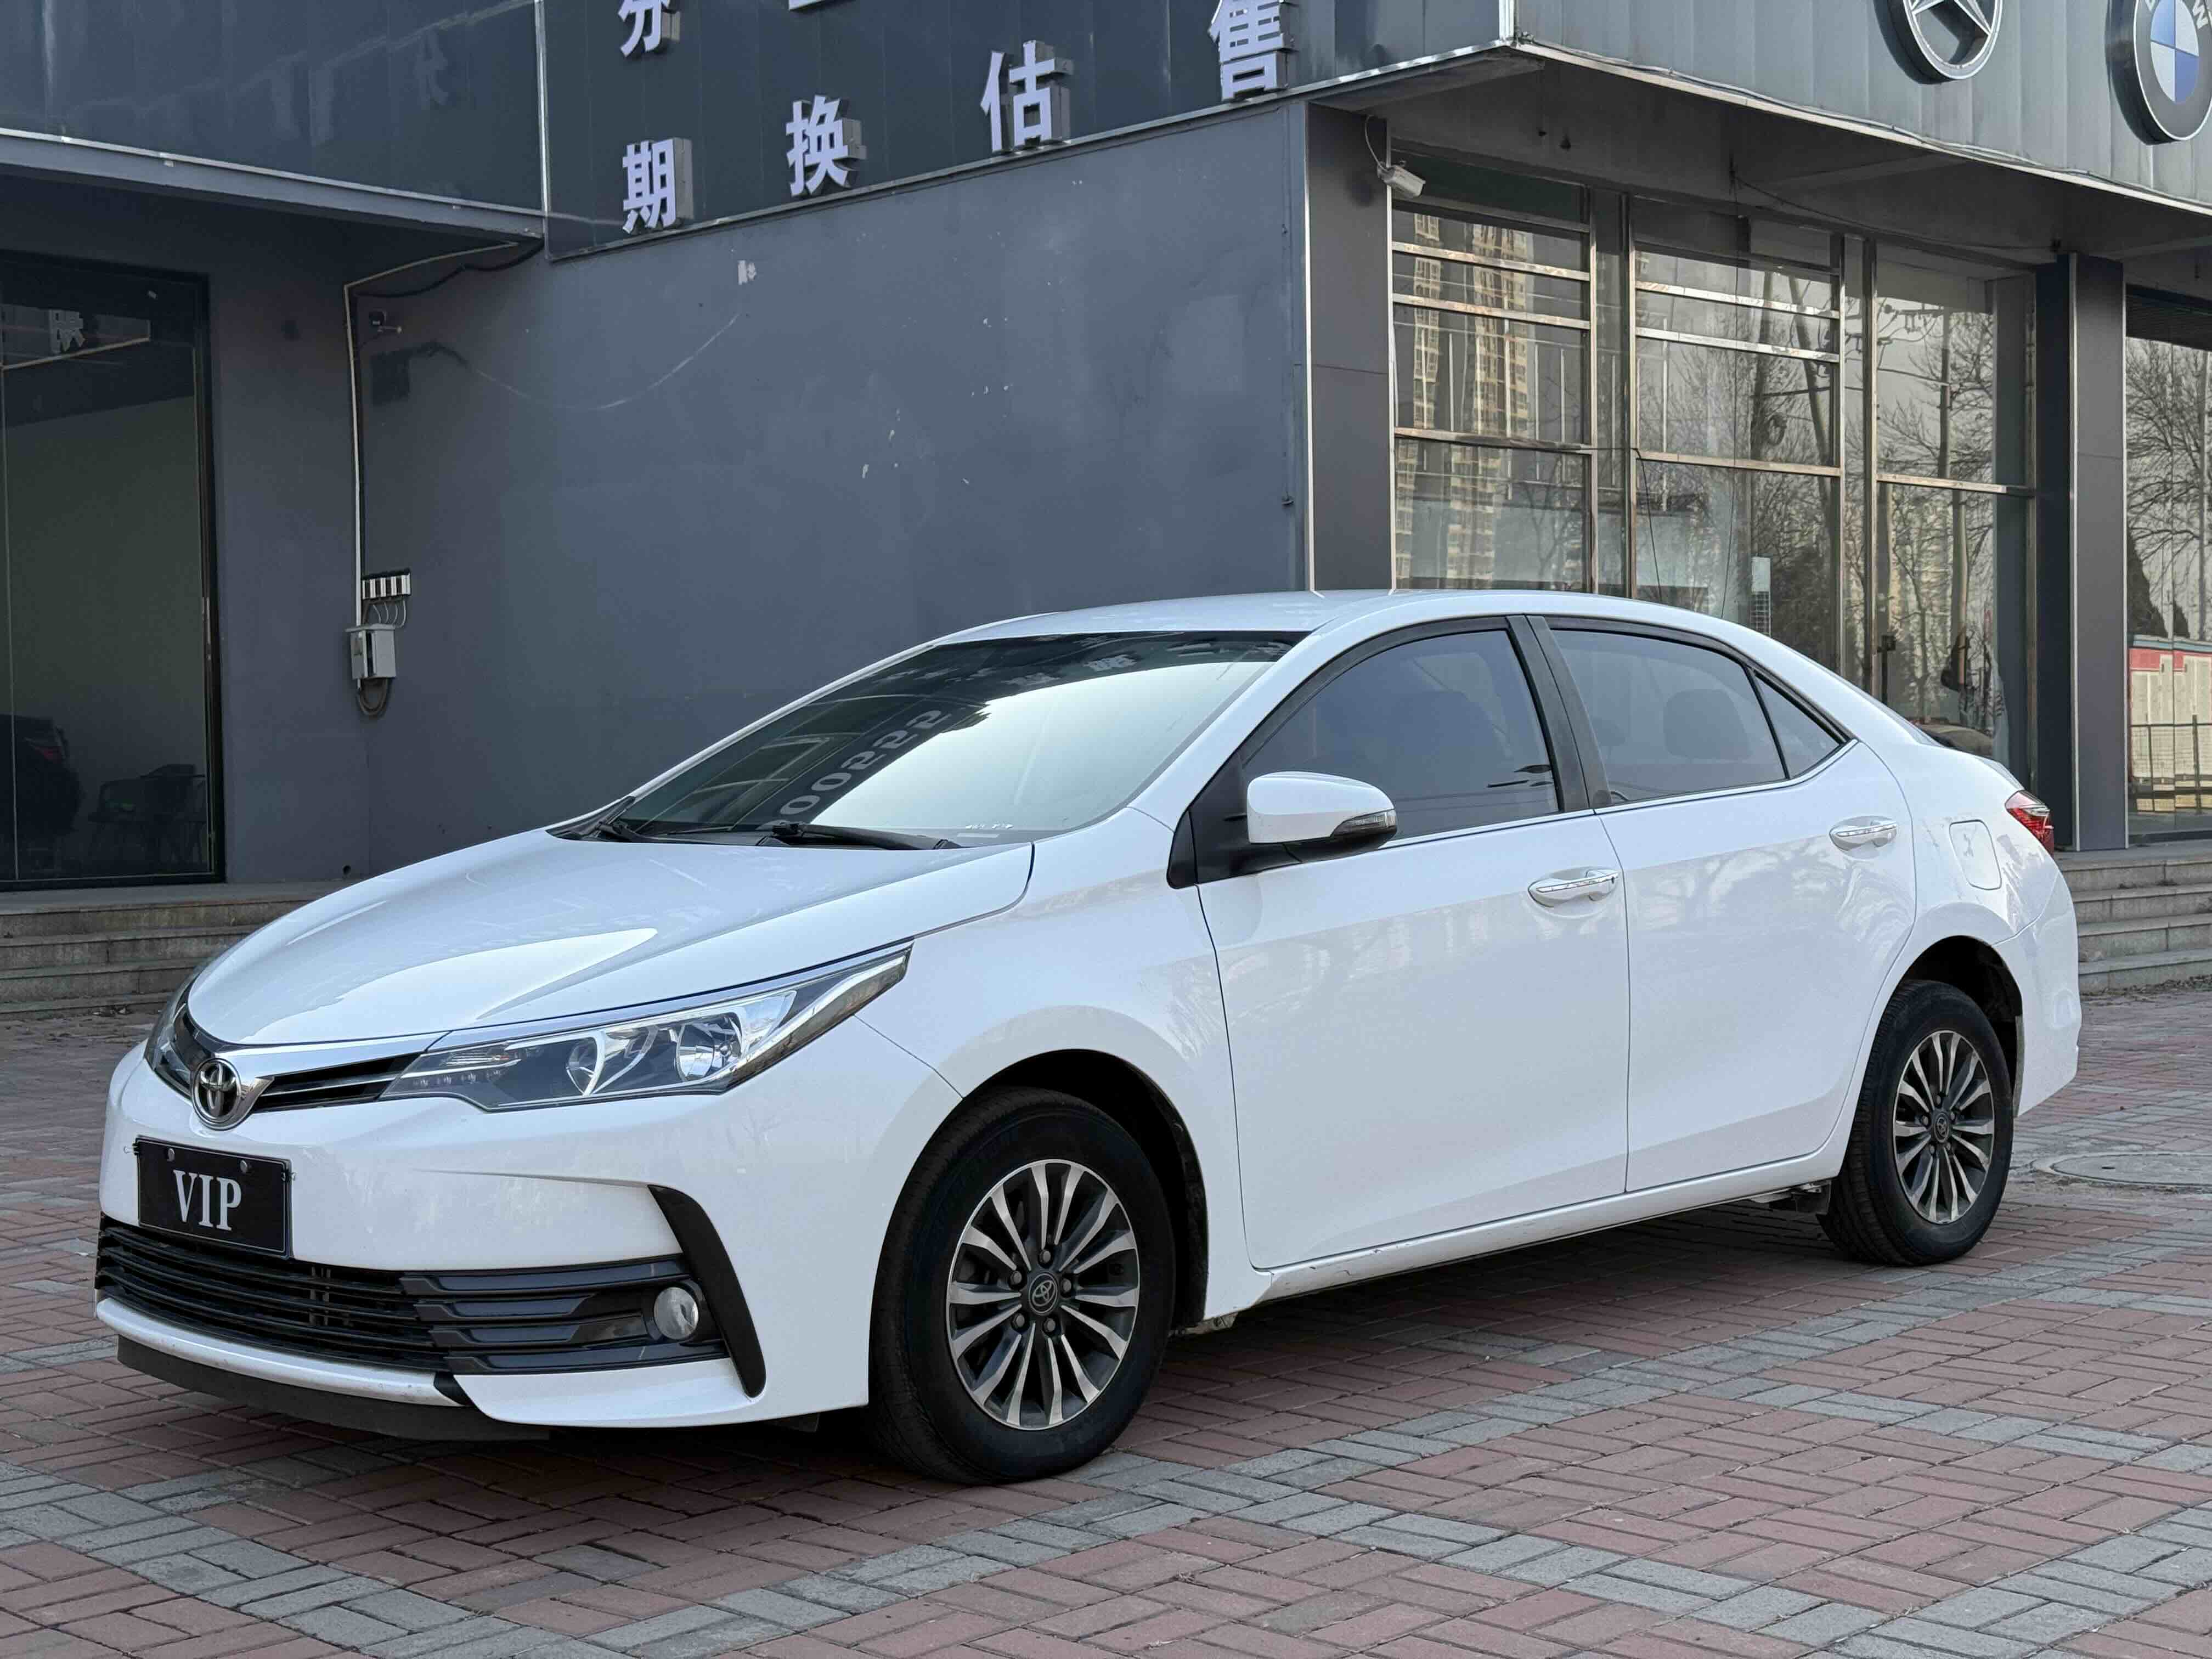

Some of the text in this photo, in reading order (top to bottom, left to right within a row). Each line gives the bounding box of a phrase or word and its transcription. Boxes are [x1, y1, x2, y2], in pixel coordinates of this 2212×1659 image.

[980, 40, 1056, 153] 估
[1207, 0, 1285, 101] 售
[173, 1169, 242, 1231] VIP
